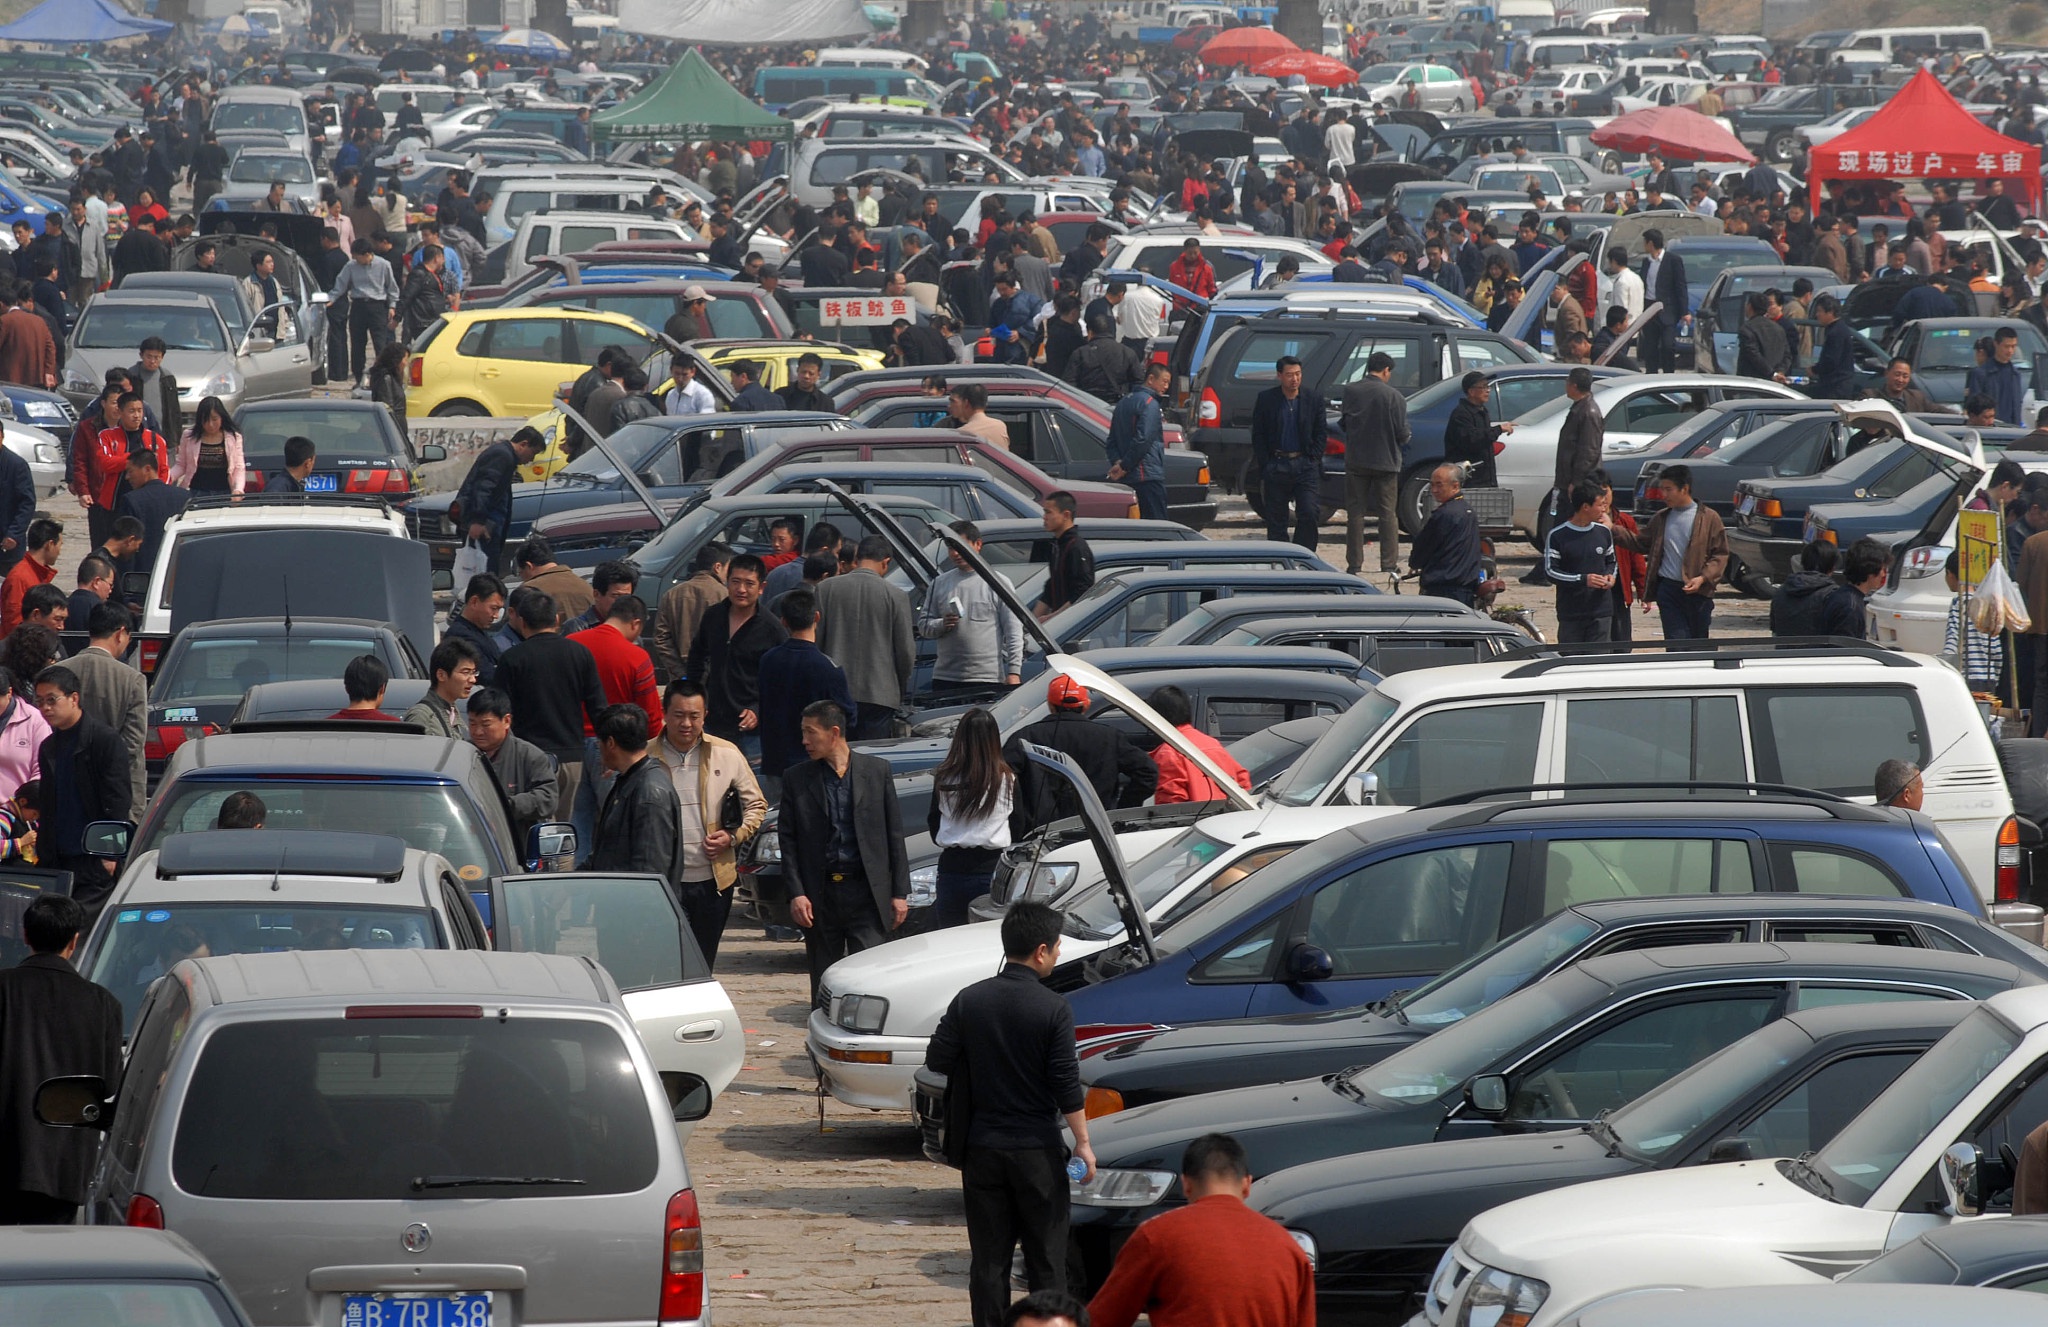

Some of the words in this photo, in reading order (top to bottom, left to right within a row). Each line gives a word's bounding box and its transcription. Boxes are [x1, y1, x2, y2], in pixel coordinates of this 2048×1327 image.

[1838, 151, 2024, 174] 现场过户、年审
[826, 299, 907, 317] 铁板鱿鱼
